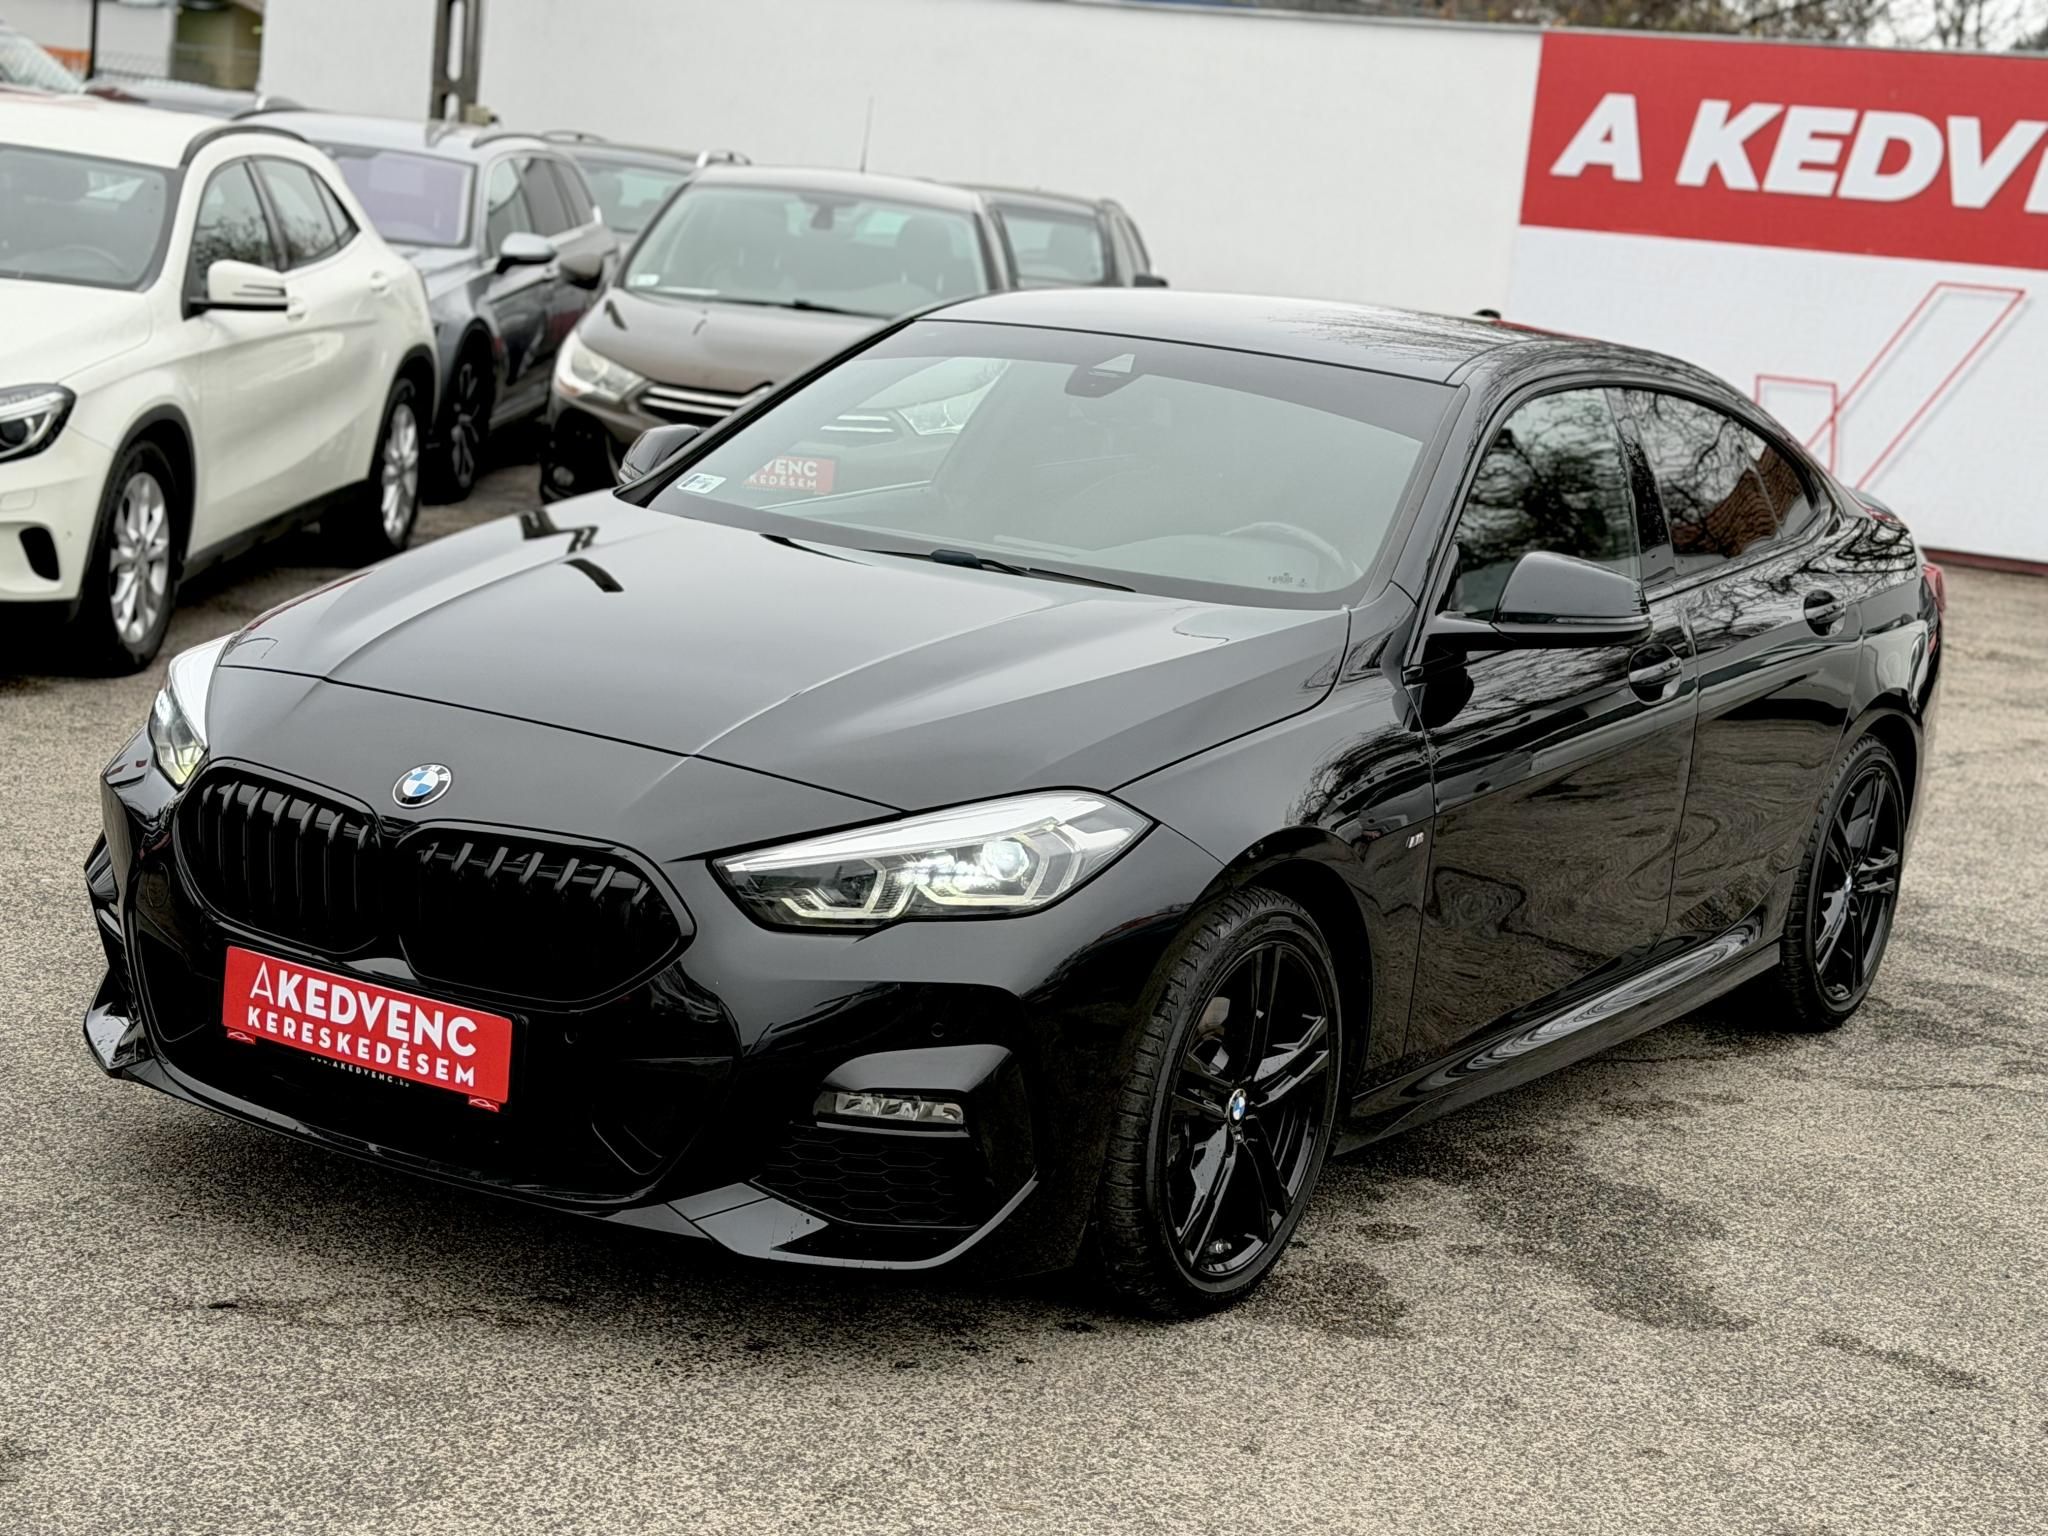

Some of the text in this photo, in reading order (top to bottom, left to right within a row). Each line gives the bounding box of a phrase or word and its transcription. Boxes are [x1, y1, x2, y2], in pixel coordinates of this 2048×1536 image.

[1549, 92, 2048, 214] A KEDV
[247, 1005, 475, 1088] KERESKEDÉSEM
